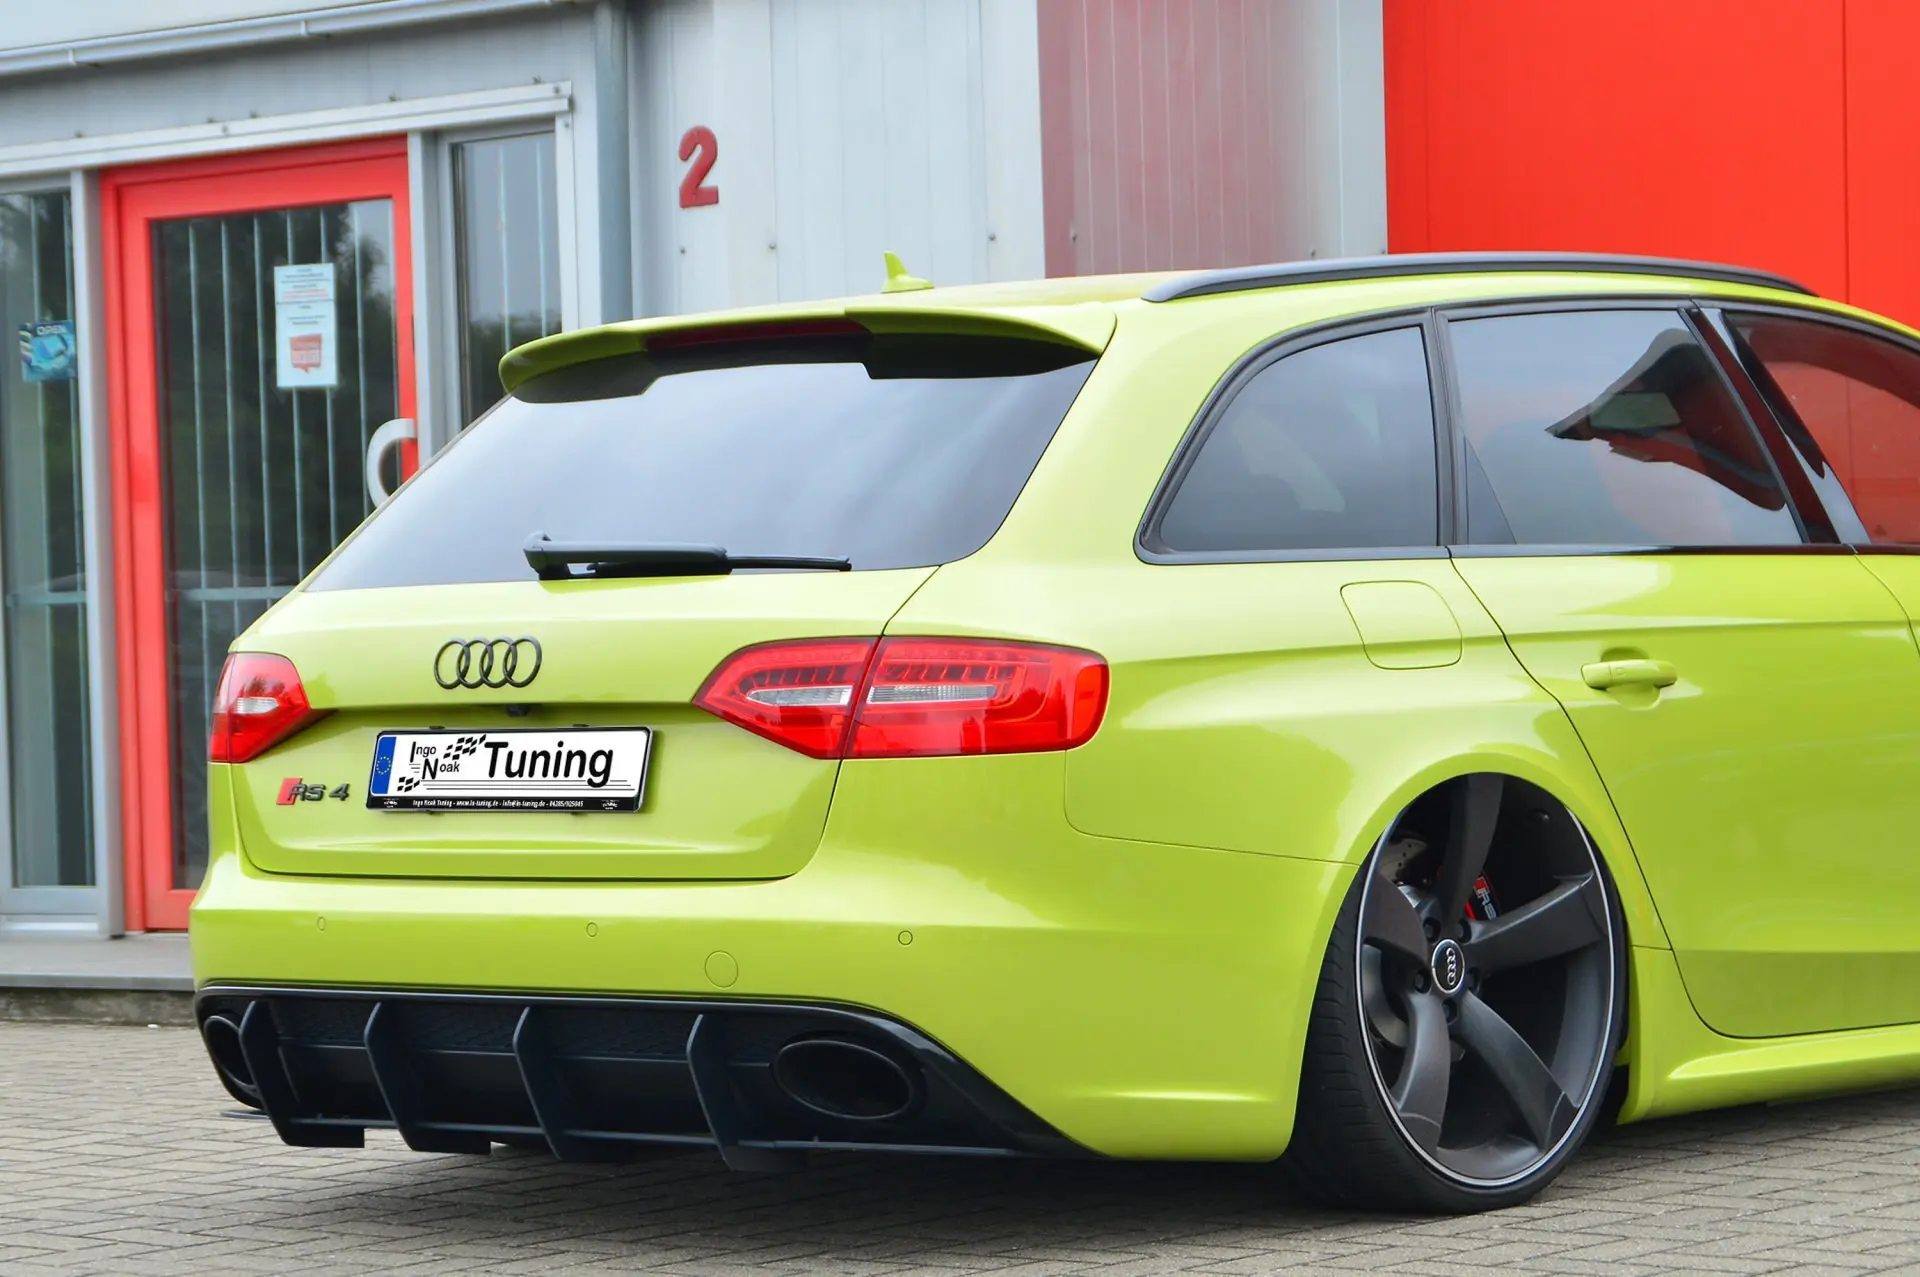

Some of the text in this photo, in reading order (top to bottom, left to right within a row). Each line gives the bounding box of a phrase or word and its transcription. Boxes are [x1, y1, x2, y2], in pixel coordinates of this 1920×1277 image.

[679, 125, 719, 208] 2
[410, 741, 437, 763] Ingo
[421, 758, 460, 780] Noak
[484, 741, 614, 788] Tuning
[287, 783, 326, 801] RS
